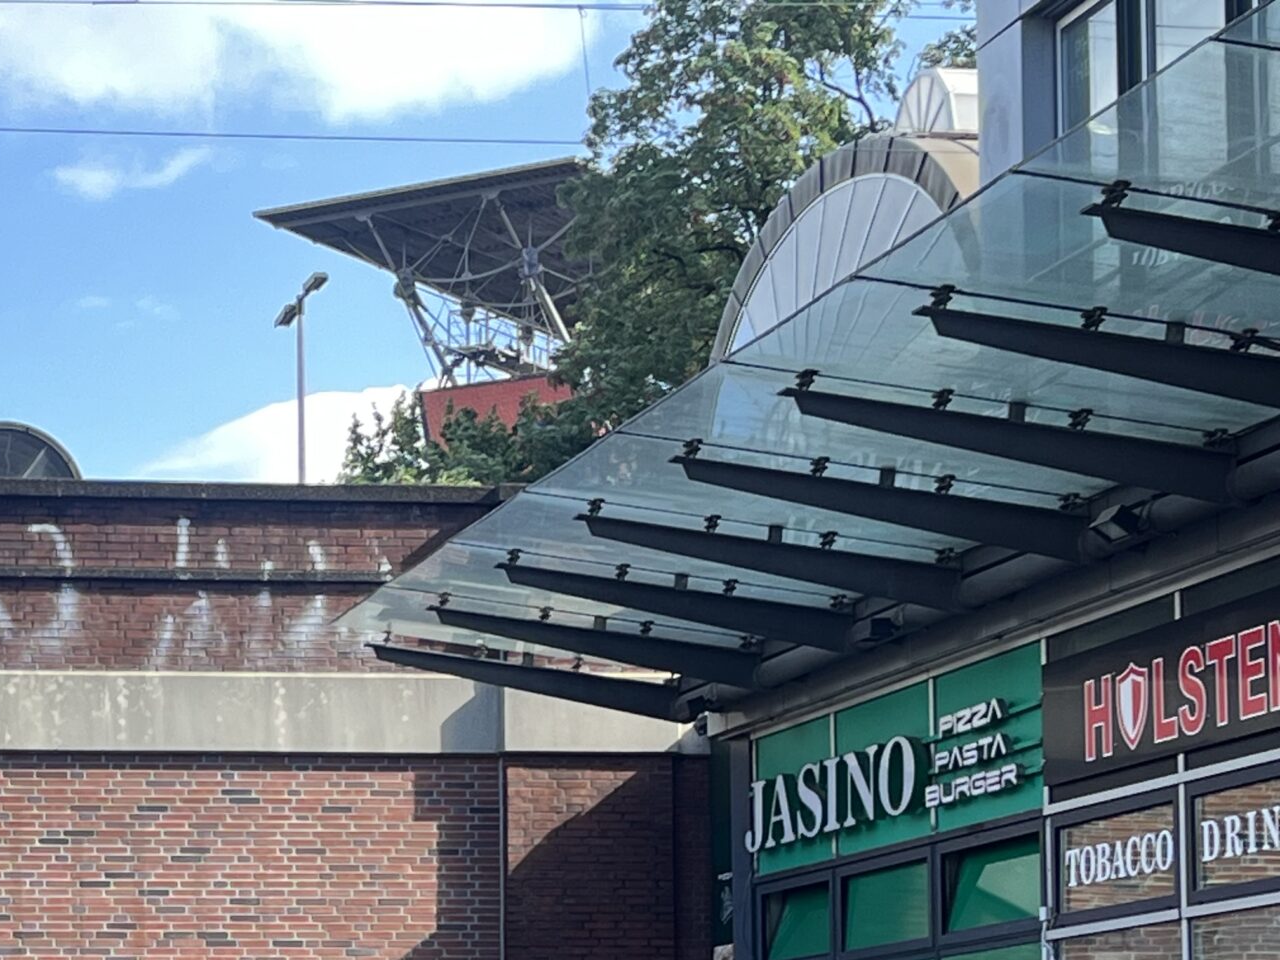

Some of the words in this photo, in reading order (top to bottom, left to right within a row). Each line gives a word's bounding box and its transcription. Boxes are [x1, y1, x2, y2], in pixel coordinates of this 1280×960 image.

[939, 697, 1002, 738] PIZZA
[935, 732, 1007, 774] PASTA
[745, 735, 915, 853] JASINO
[925, 763, 1019, 809] BURGER
[1065, 829, 1175, 887] TOBACCO
